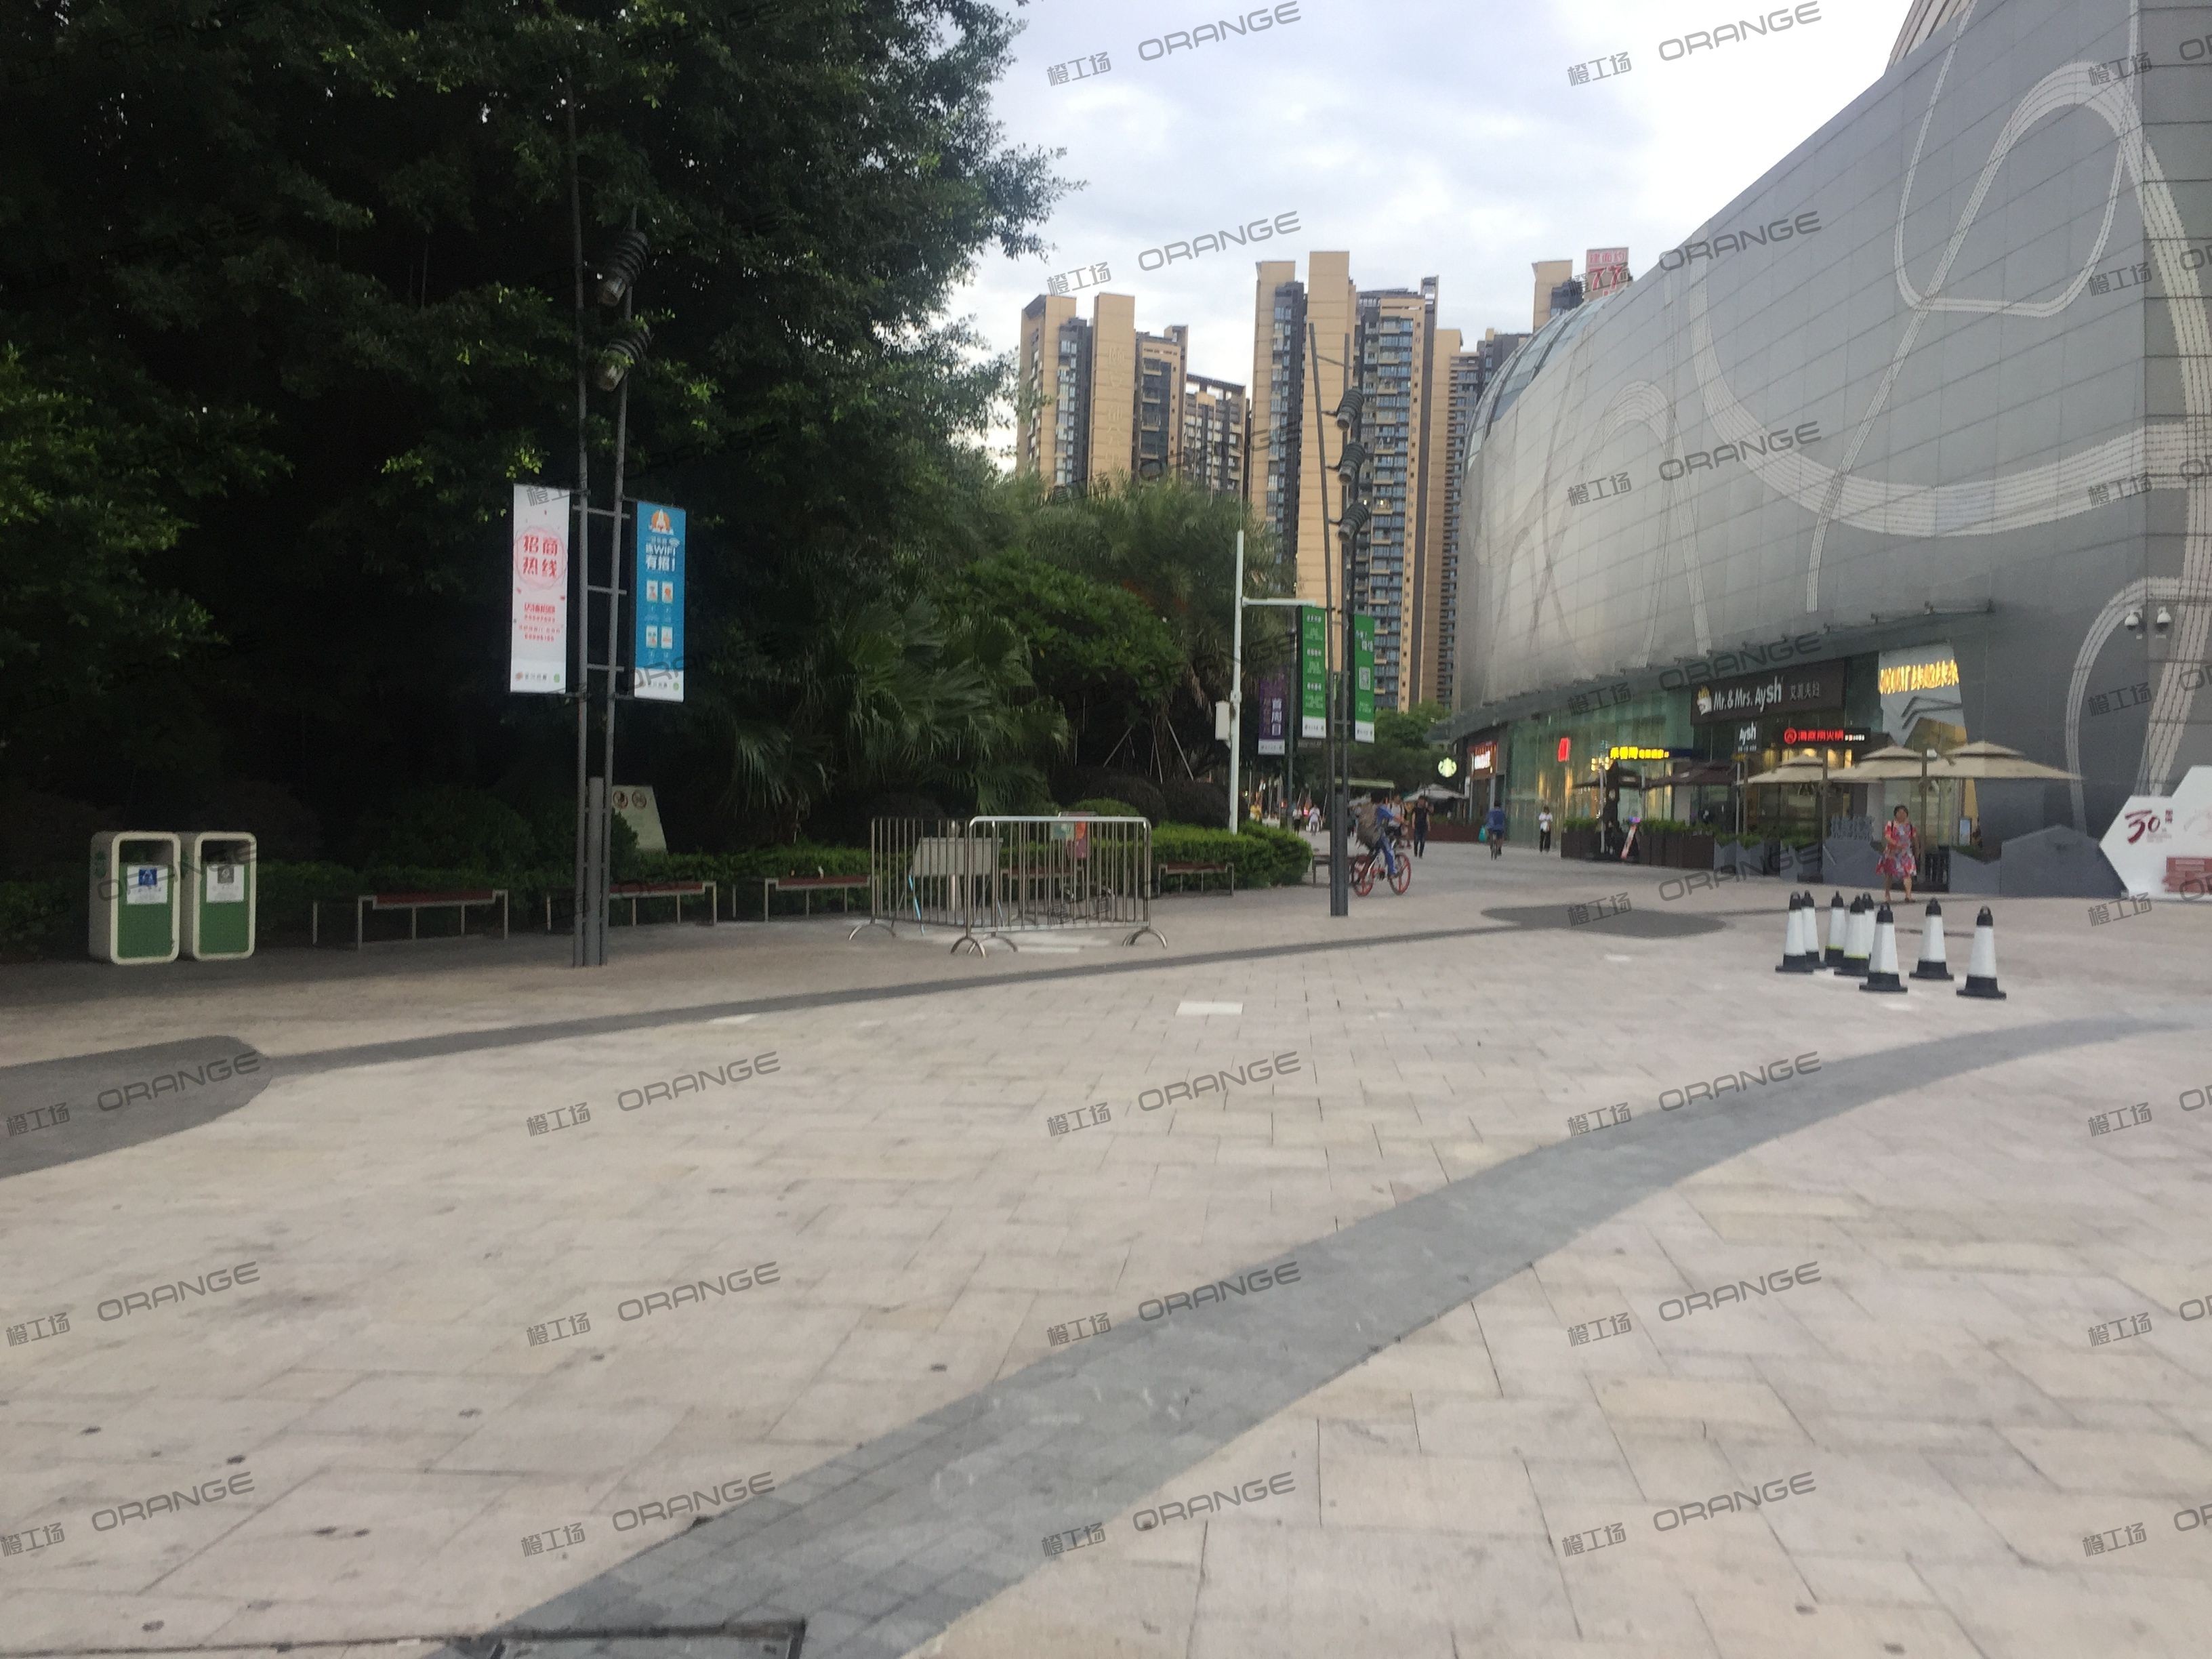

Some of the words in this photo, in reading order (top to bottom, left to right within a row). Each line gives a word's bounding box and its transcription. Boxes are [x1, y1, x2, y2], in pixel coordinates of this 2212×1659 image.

[524, 535, 558, 556] 招商
[523, 556, 557, 578] 热线
[1755, 676, 1782, 713] Aysh
[1739, 720, 1757, 747] Aysh
